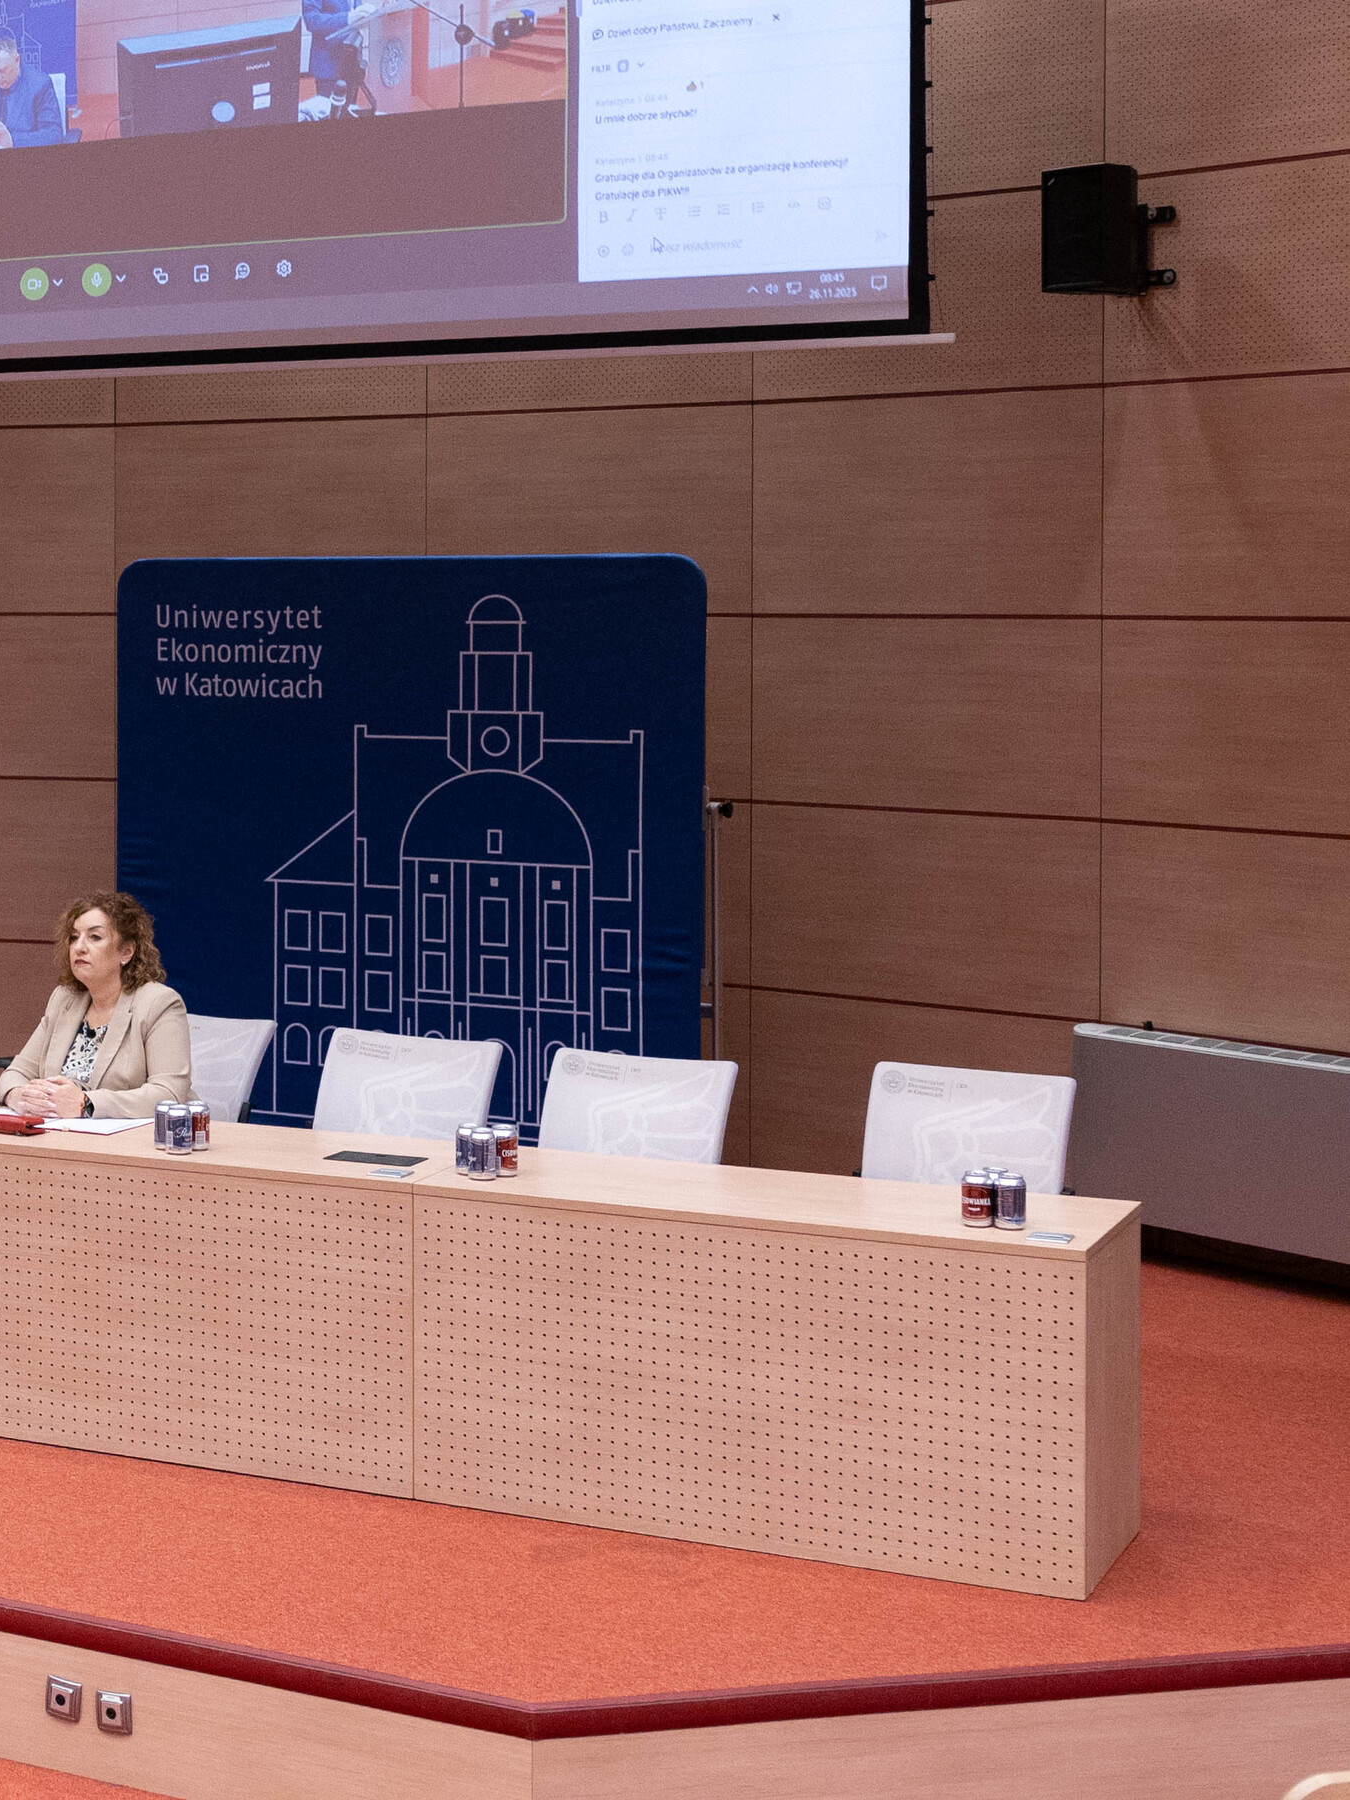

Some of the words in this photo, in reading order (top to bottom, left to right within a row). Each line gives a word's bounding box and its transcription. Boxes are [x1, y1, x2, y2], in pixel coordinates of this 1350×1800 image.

[595, 115, 602, 124] U
[603, 114, 625, 124] mnie
[627, 112, 658, 121] dobrze
[595, 172, 640, 183] Gratulacje
[641, 171, 656, 180] dla
[657, 166, 723, 181] Organizatorów
[595, 190, 640, 201] Gratulacje
[641, 189, 656, 199] dla
[156, 603, 323, 635] Uniwersytet
[156, 637, 323, 670] Ekonomiczny
[156, 676, 178, 696] w
[184, 672, 323, 699] Katowicach
